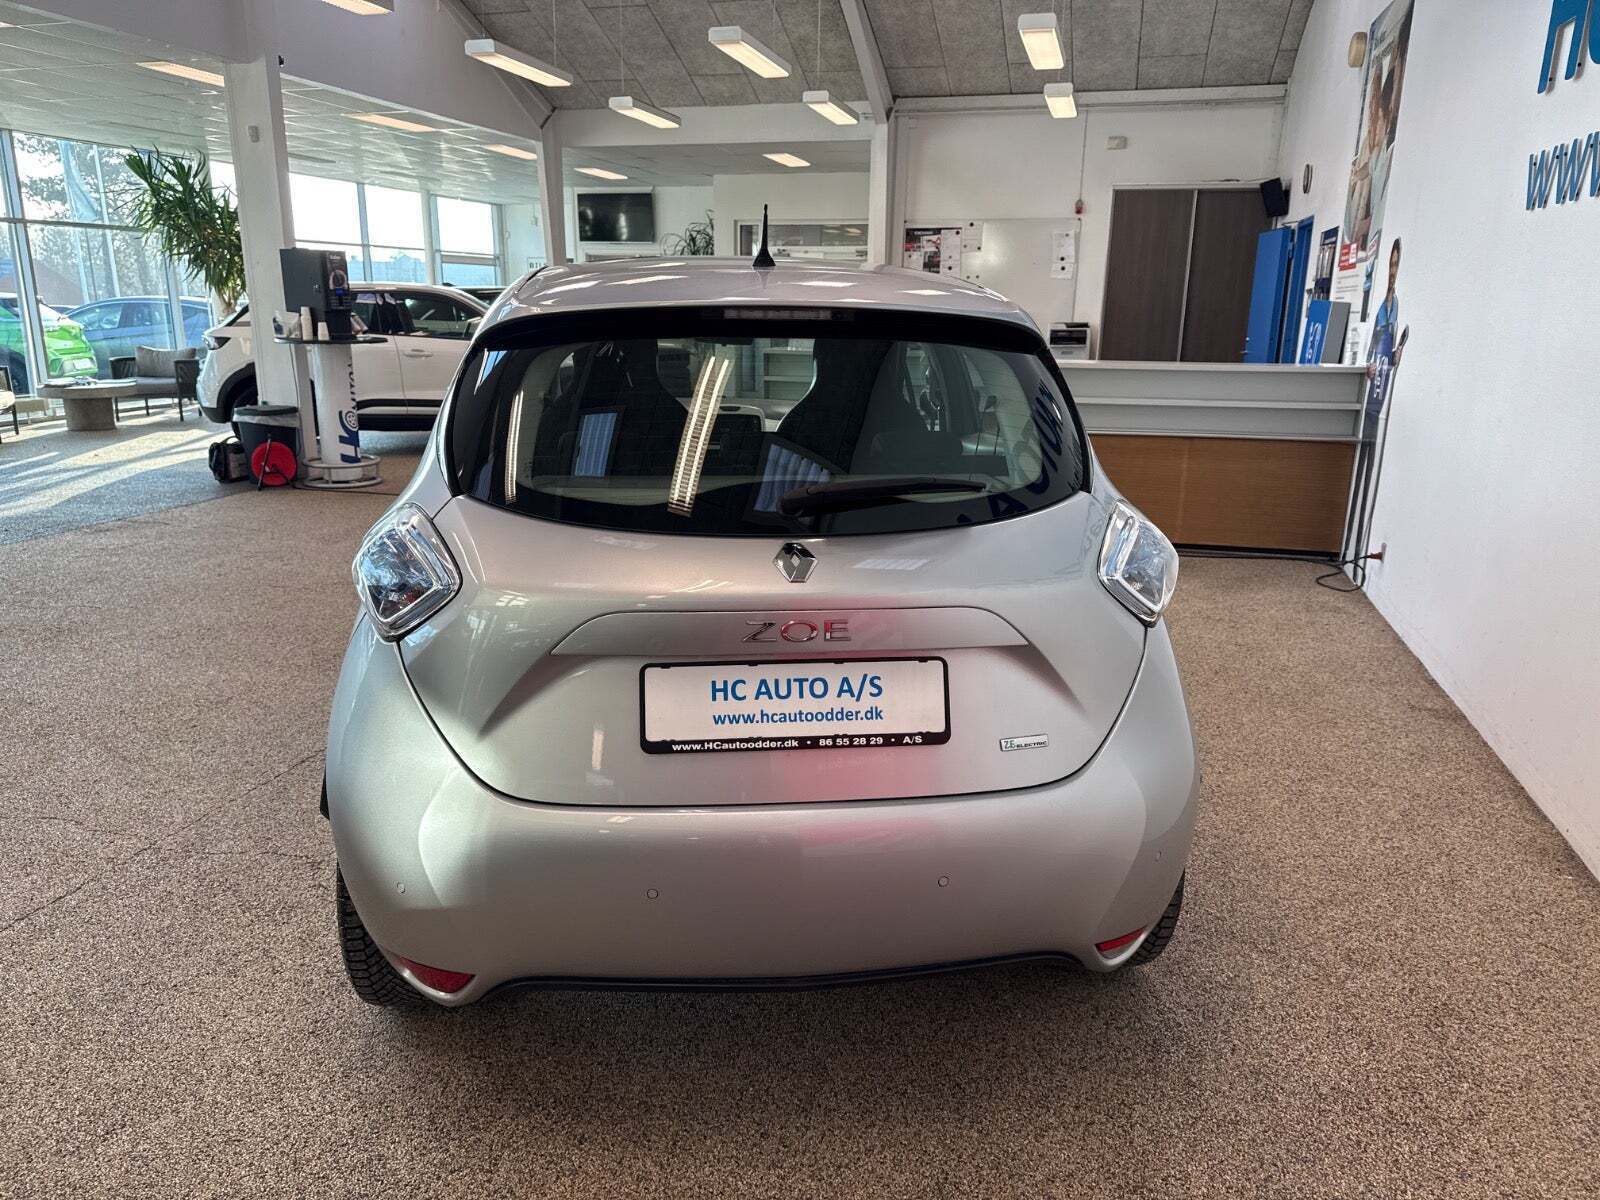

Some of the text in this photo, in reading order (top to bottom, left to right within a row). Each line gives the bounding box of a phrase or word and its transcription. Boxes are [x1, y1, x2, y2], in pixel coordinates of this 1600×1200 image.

[742, 619, 851, 642] ZOE
[711, 673, 883, 702] HC AUTO A/S
[712, 706, 884, 725] www.hcautoodder.dk
[671, 735, 923, 751] www.HCautoodder.dk 86 55 28 29 A/S
